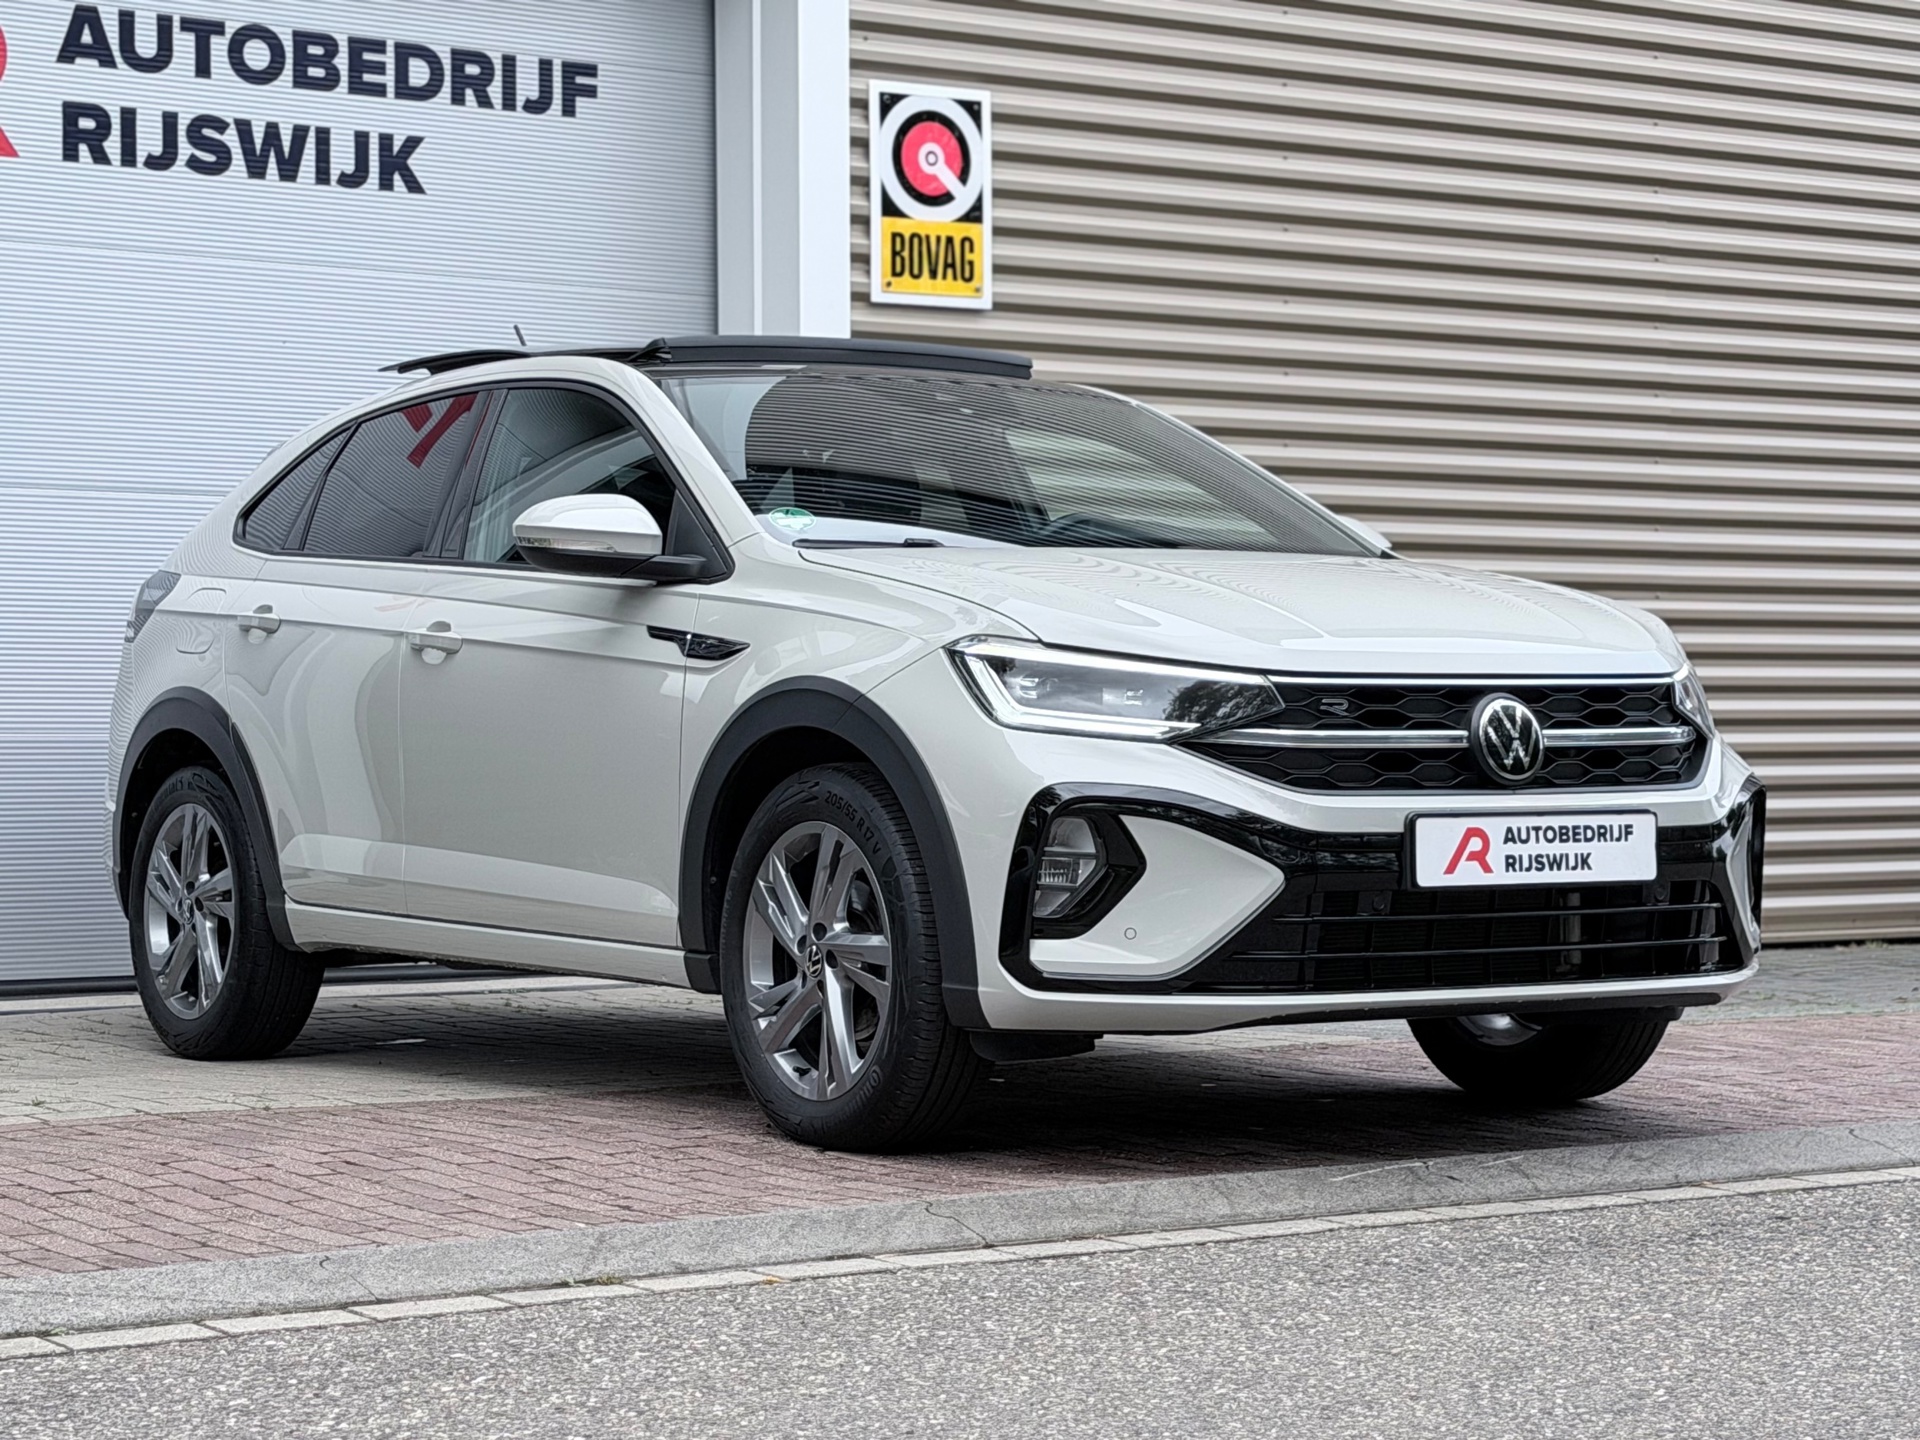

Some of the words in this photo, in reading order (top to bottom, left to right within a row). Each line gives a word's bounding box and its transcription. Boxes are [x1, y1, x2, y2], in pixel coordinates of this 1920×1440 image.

[56, 4, 598, 118] AUTOBEDRIJF
[62, 101, 427, 194] RIJSWIJK
[891, 231, 975, 283] BOVAG
[825, 790, 858, 823] 205/55
[856, 817, 866, 832] R
[864, 827, 875, 842] 17
[1503, 824, 1634, 845] AUTOBEDRIJF
[1504, 852, 1592, 873] RIJSWIJK
